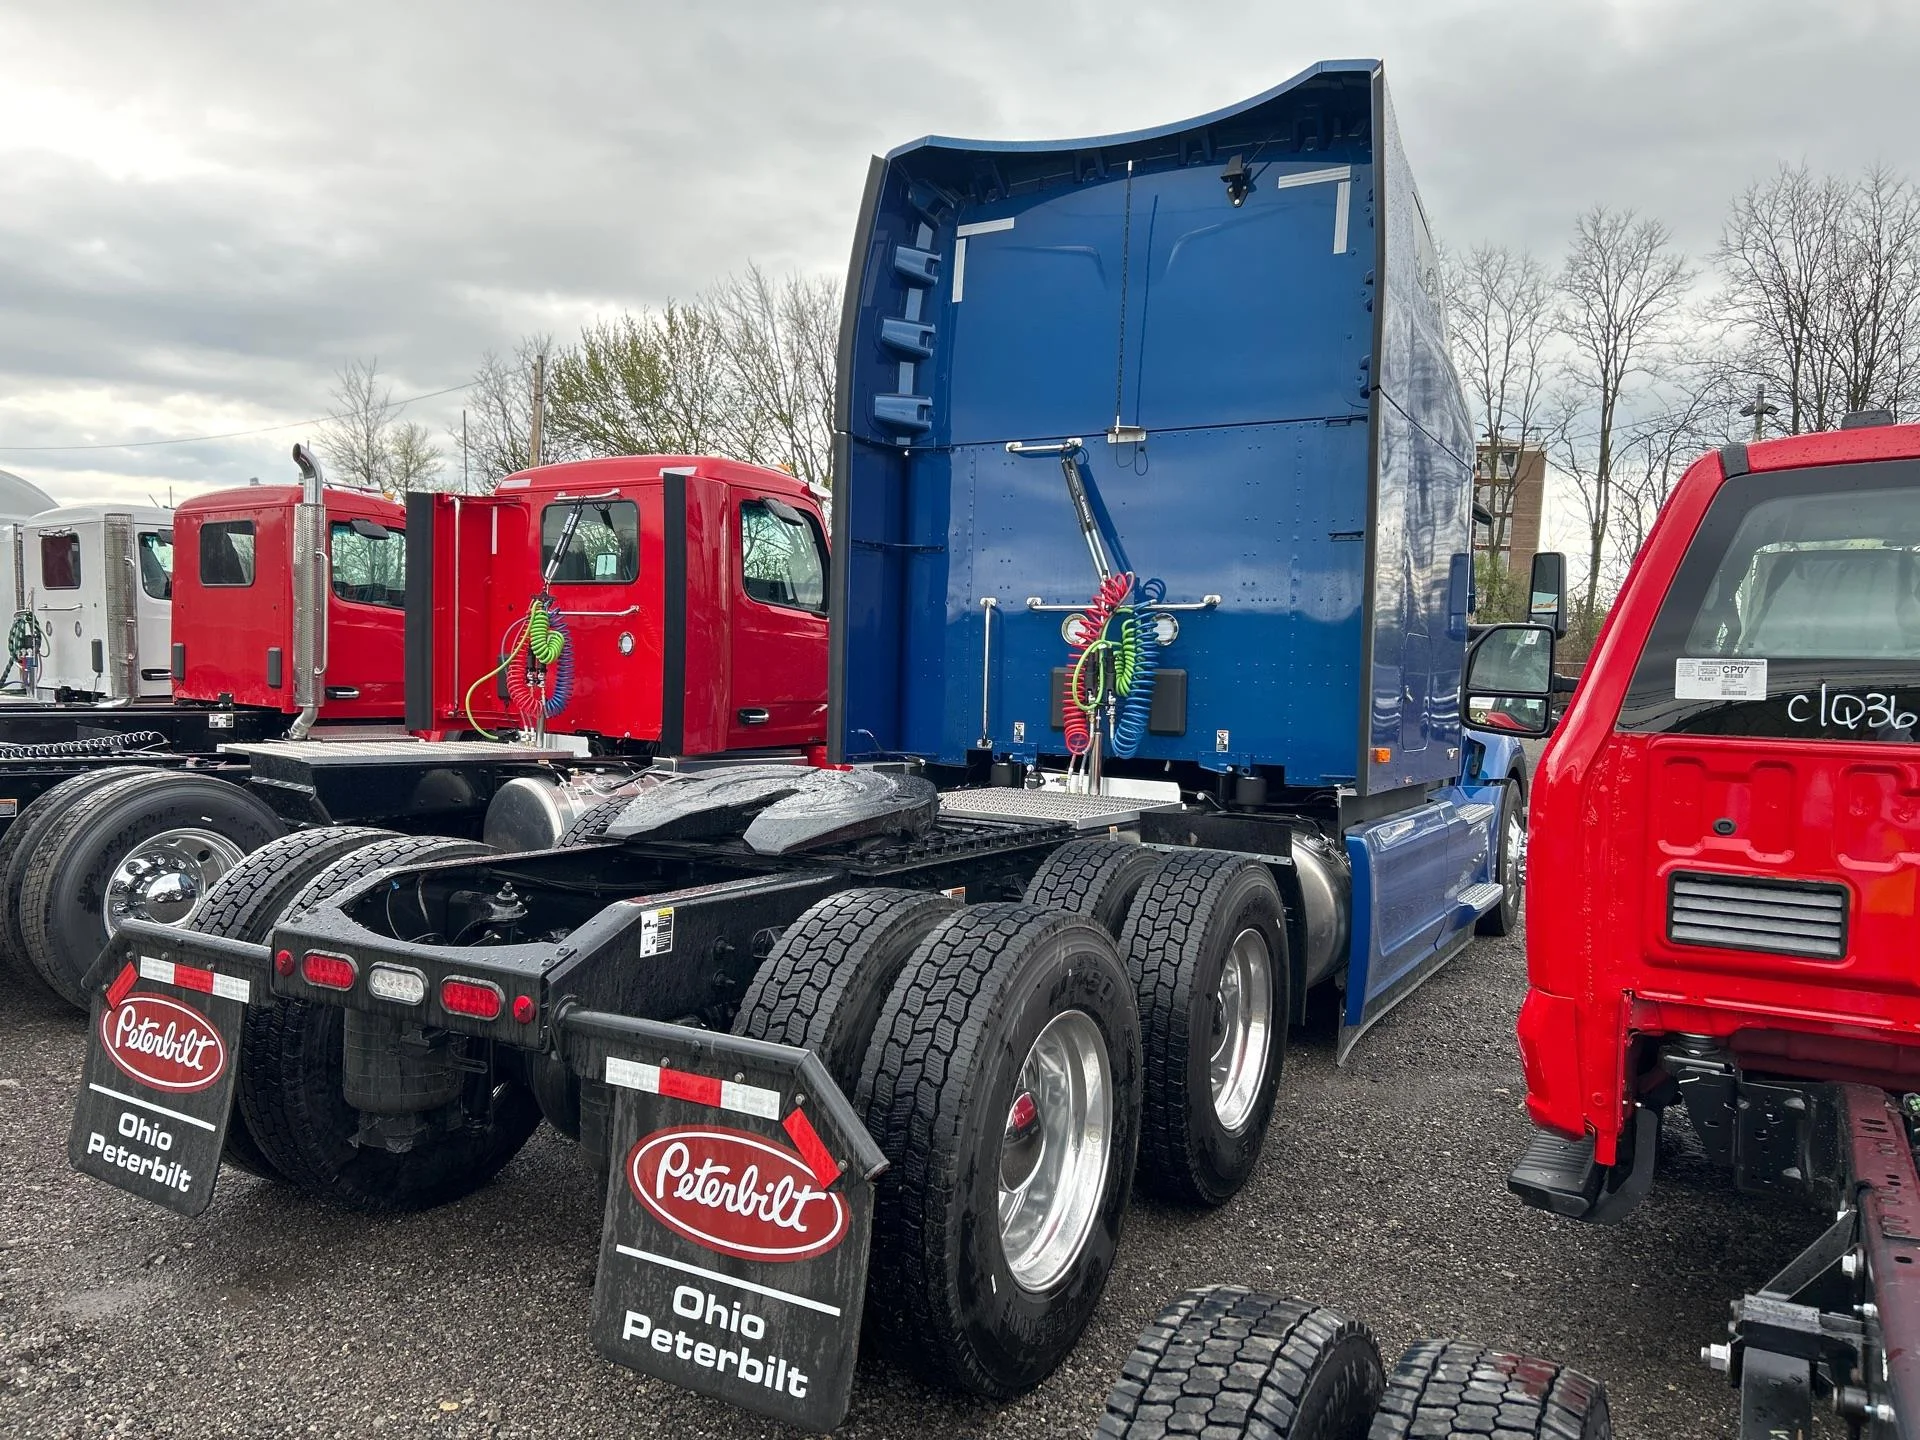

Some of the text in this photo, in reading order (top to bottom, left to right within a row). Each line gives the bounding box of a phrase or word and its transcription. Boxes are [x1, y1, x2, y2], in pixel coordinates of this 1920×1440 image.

[1722, 665, 1750, 674] CP07
[115, 1004, 216, 1071] Peterbilt
[86, 1131, 192, 1193] Peterbilt
[118, 1111, 173, 1151] Ohio
[656, 1141, 829, 1232] Peterbilt
[672, 1285, 765, 1340] Ohio
[622, 1309, 809, 1399] Peterbilt
